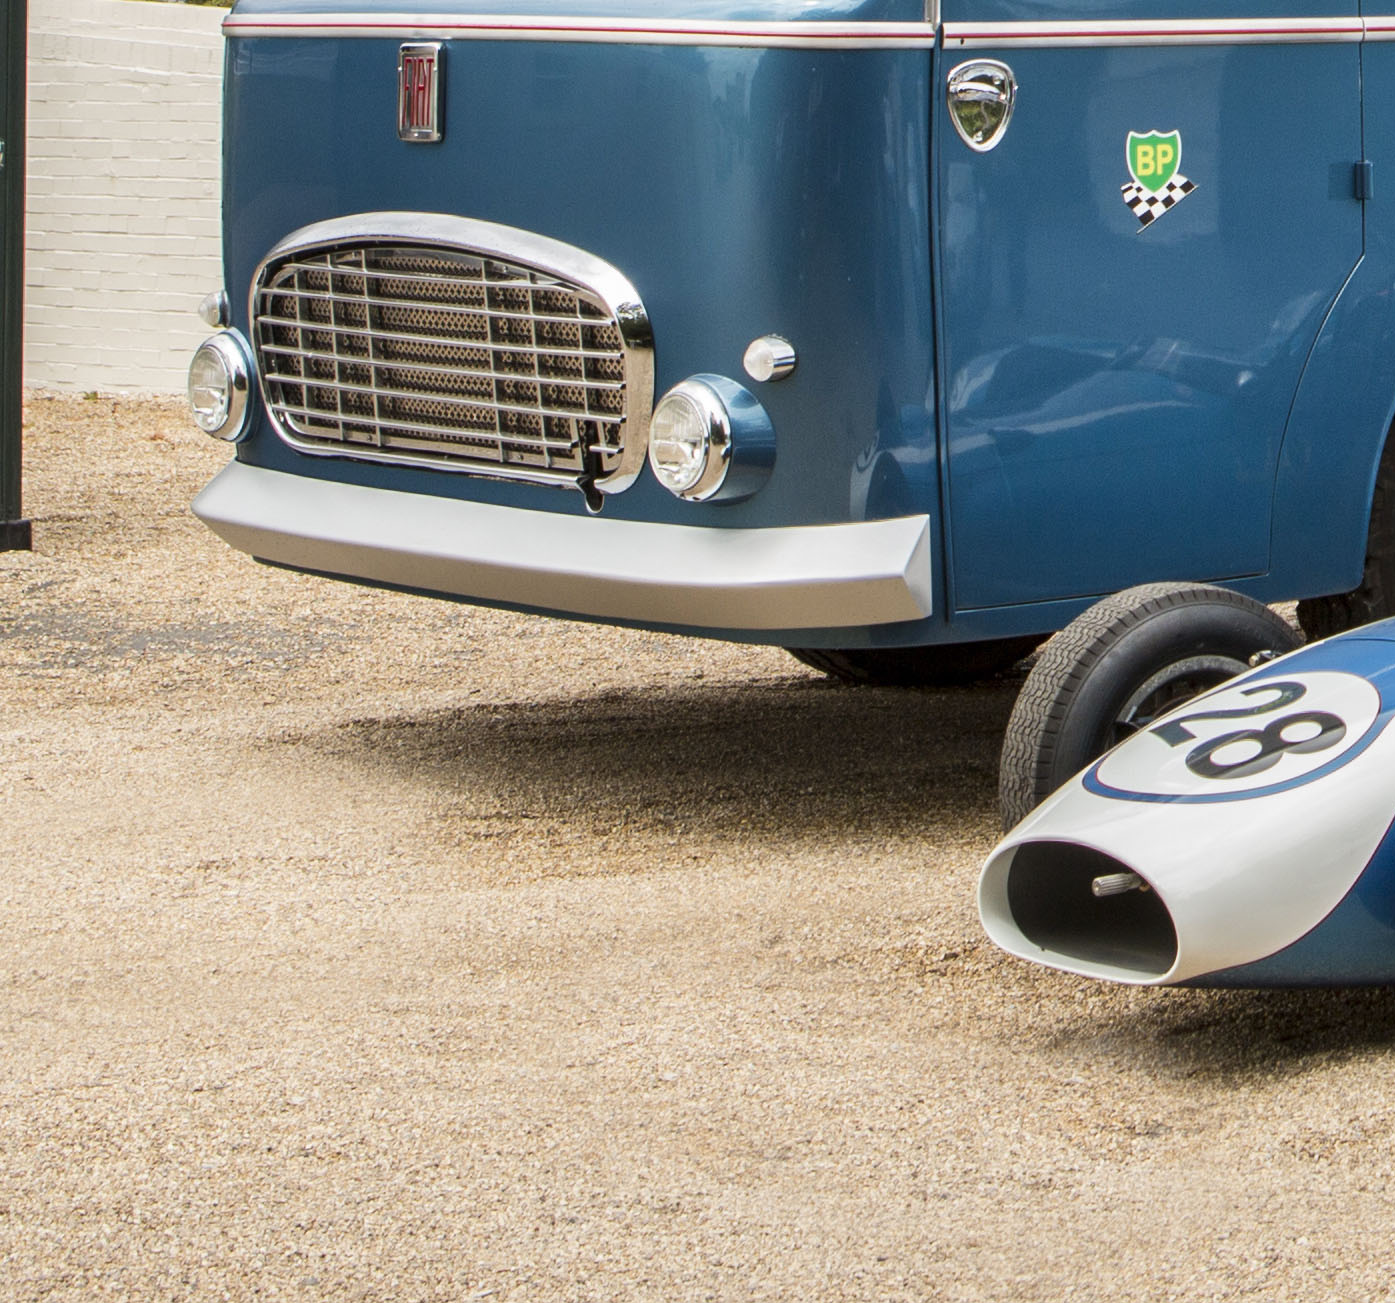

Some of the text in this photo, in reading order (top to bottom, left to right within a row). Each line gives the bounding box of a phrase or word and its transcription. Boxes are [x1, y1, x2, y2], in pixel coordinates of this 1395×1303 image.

[402, 57, 435, 127] FIAT
[1137, 144, 1174, 176] BP
[1148, 681, 1347, 780] 28
